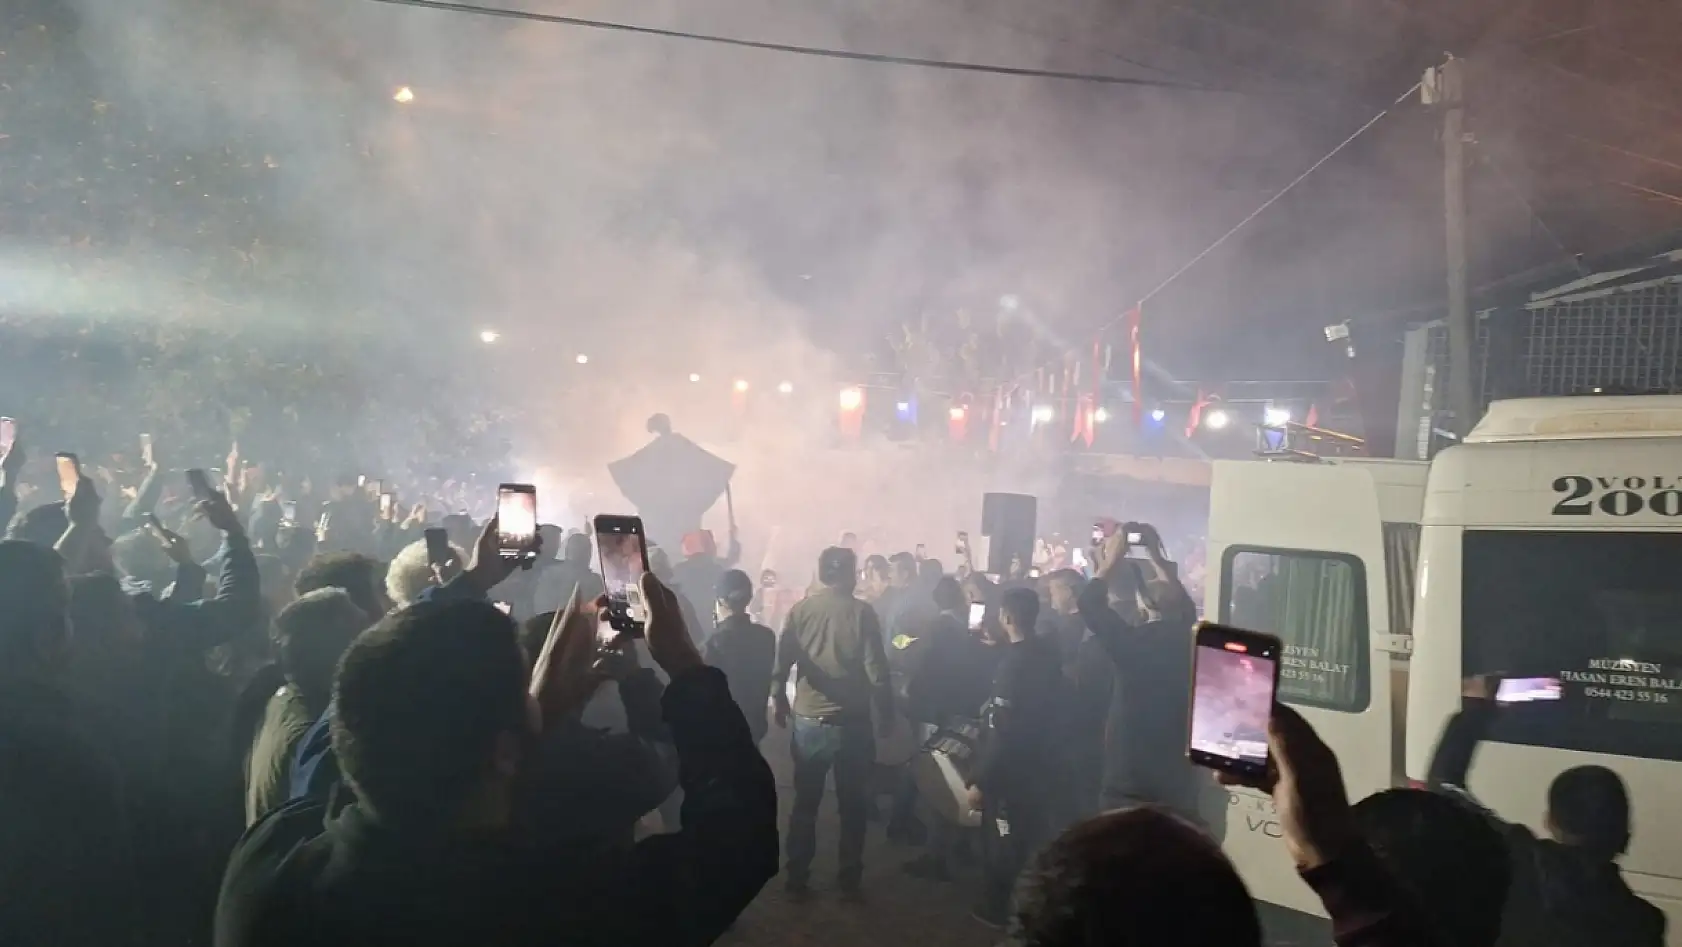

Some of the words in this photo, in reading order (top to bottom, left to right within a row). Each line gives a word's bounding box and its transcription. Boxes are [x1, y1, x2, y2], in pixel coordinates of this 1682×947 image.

[1596, 475, 1682, 489] VOL
[1609, 674, 1648, 687] EREN
[1649, 677, 1682, 690] BAL
[1614, 689, 1634, 701] 423
[1637, 691, 1651, 702] 55
[1654, 692, 1669, 703] 16
